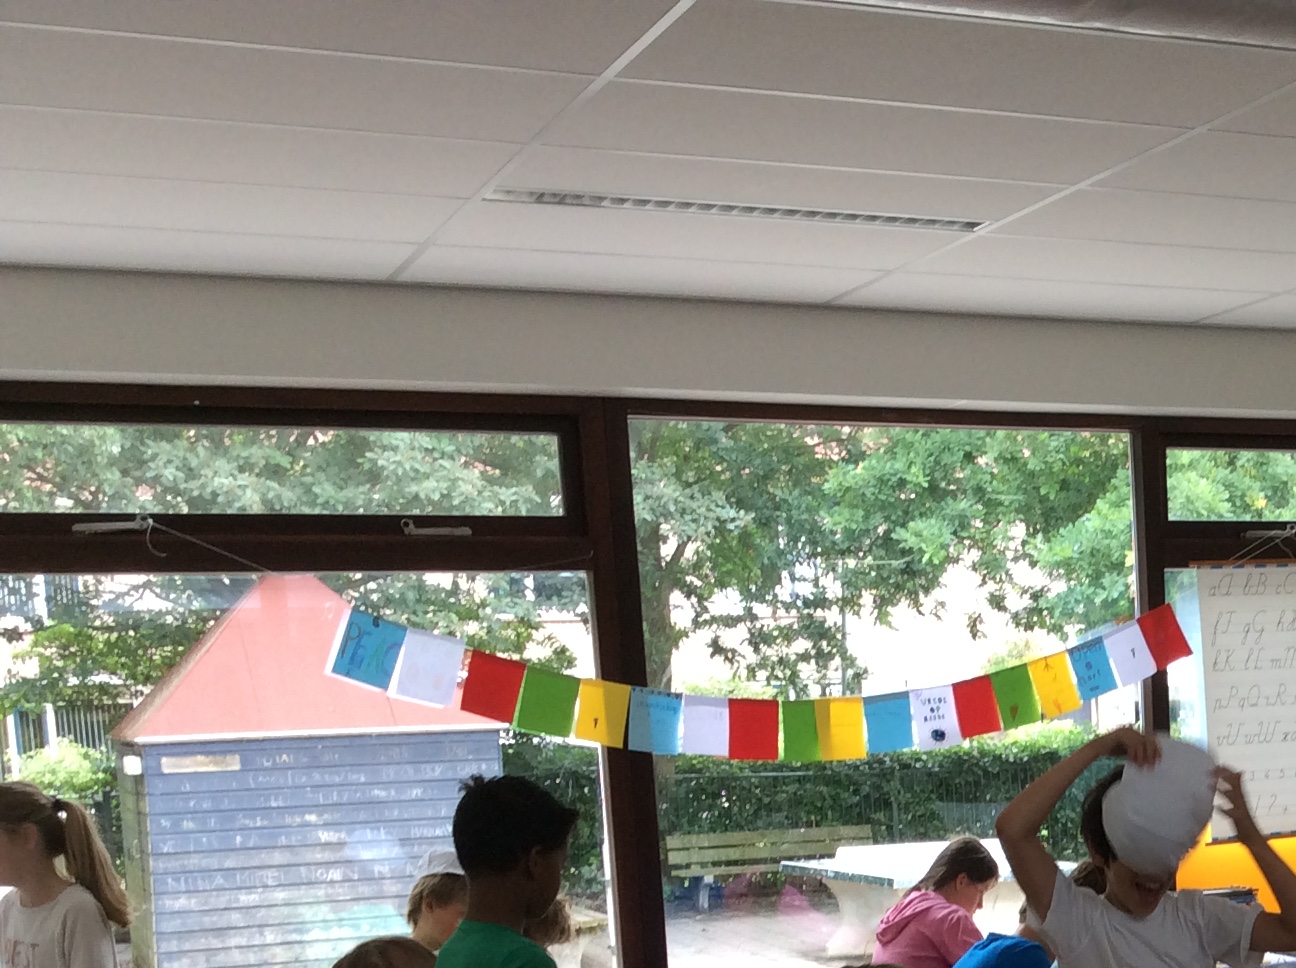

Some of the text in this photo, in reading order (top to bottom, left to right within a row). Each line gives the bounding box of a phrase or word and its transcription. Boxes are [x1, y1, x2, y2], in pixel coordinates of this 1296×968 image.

[1249, 771, 1255, 781] 3
[1264, 769, 1270, 780] 4
[1279, 768, 1286, 779] 5
